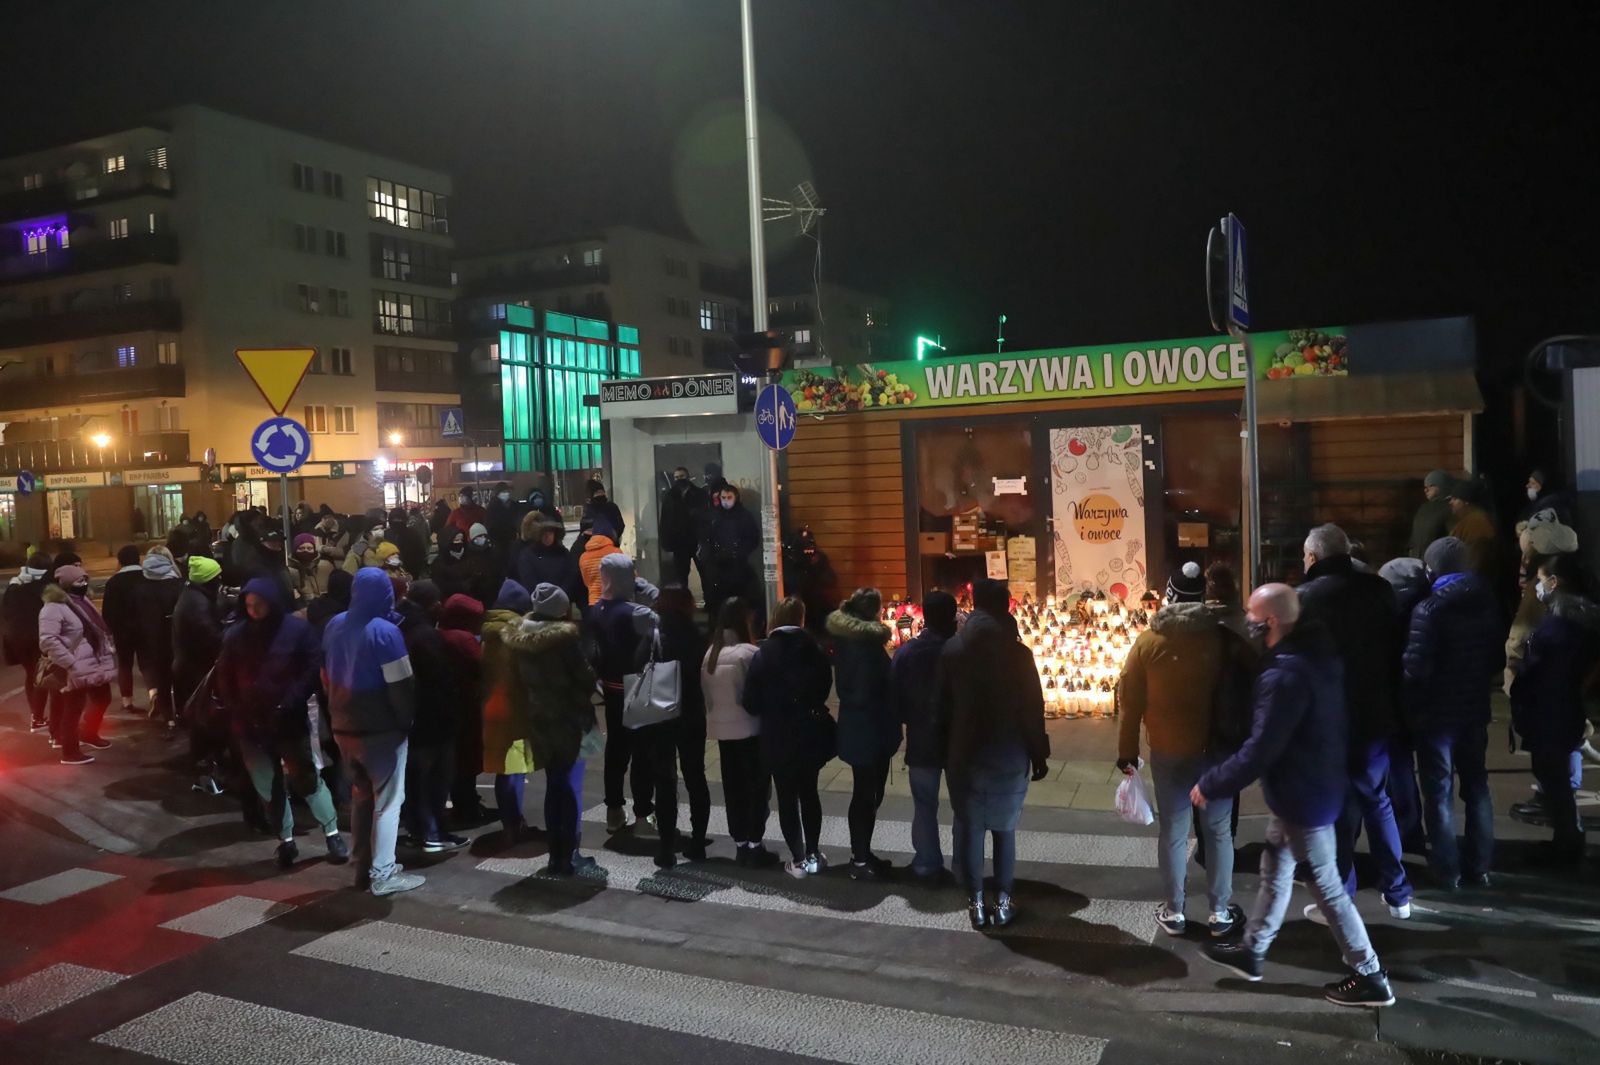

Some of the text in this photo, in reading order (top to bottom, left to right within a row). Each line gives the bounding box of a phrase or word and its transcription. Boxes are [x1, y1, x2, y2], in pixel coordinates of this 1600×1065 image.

[924, 343, 1248, 399] WARZYWA I OWOCE
[602, 383, 652, 402] MEMO
[671, 377, 735, 398] DÖNER
[1066, 497, 1128, 526] Warzywa
[1080, 525, 1122, 540] i owoce
